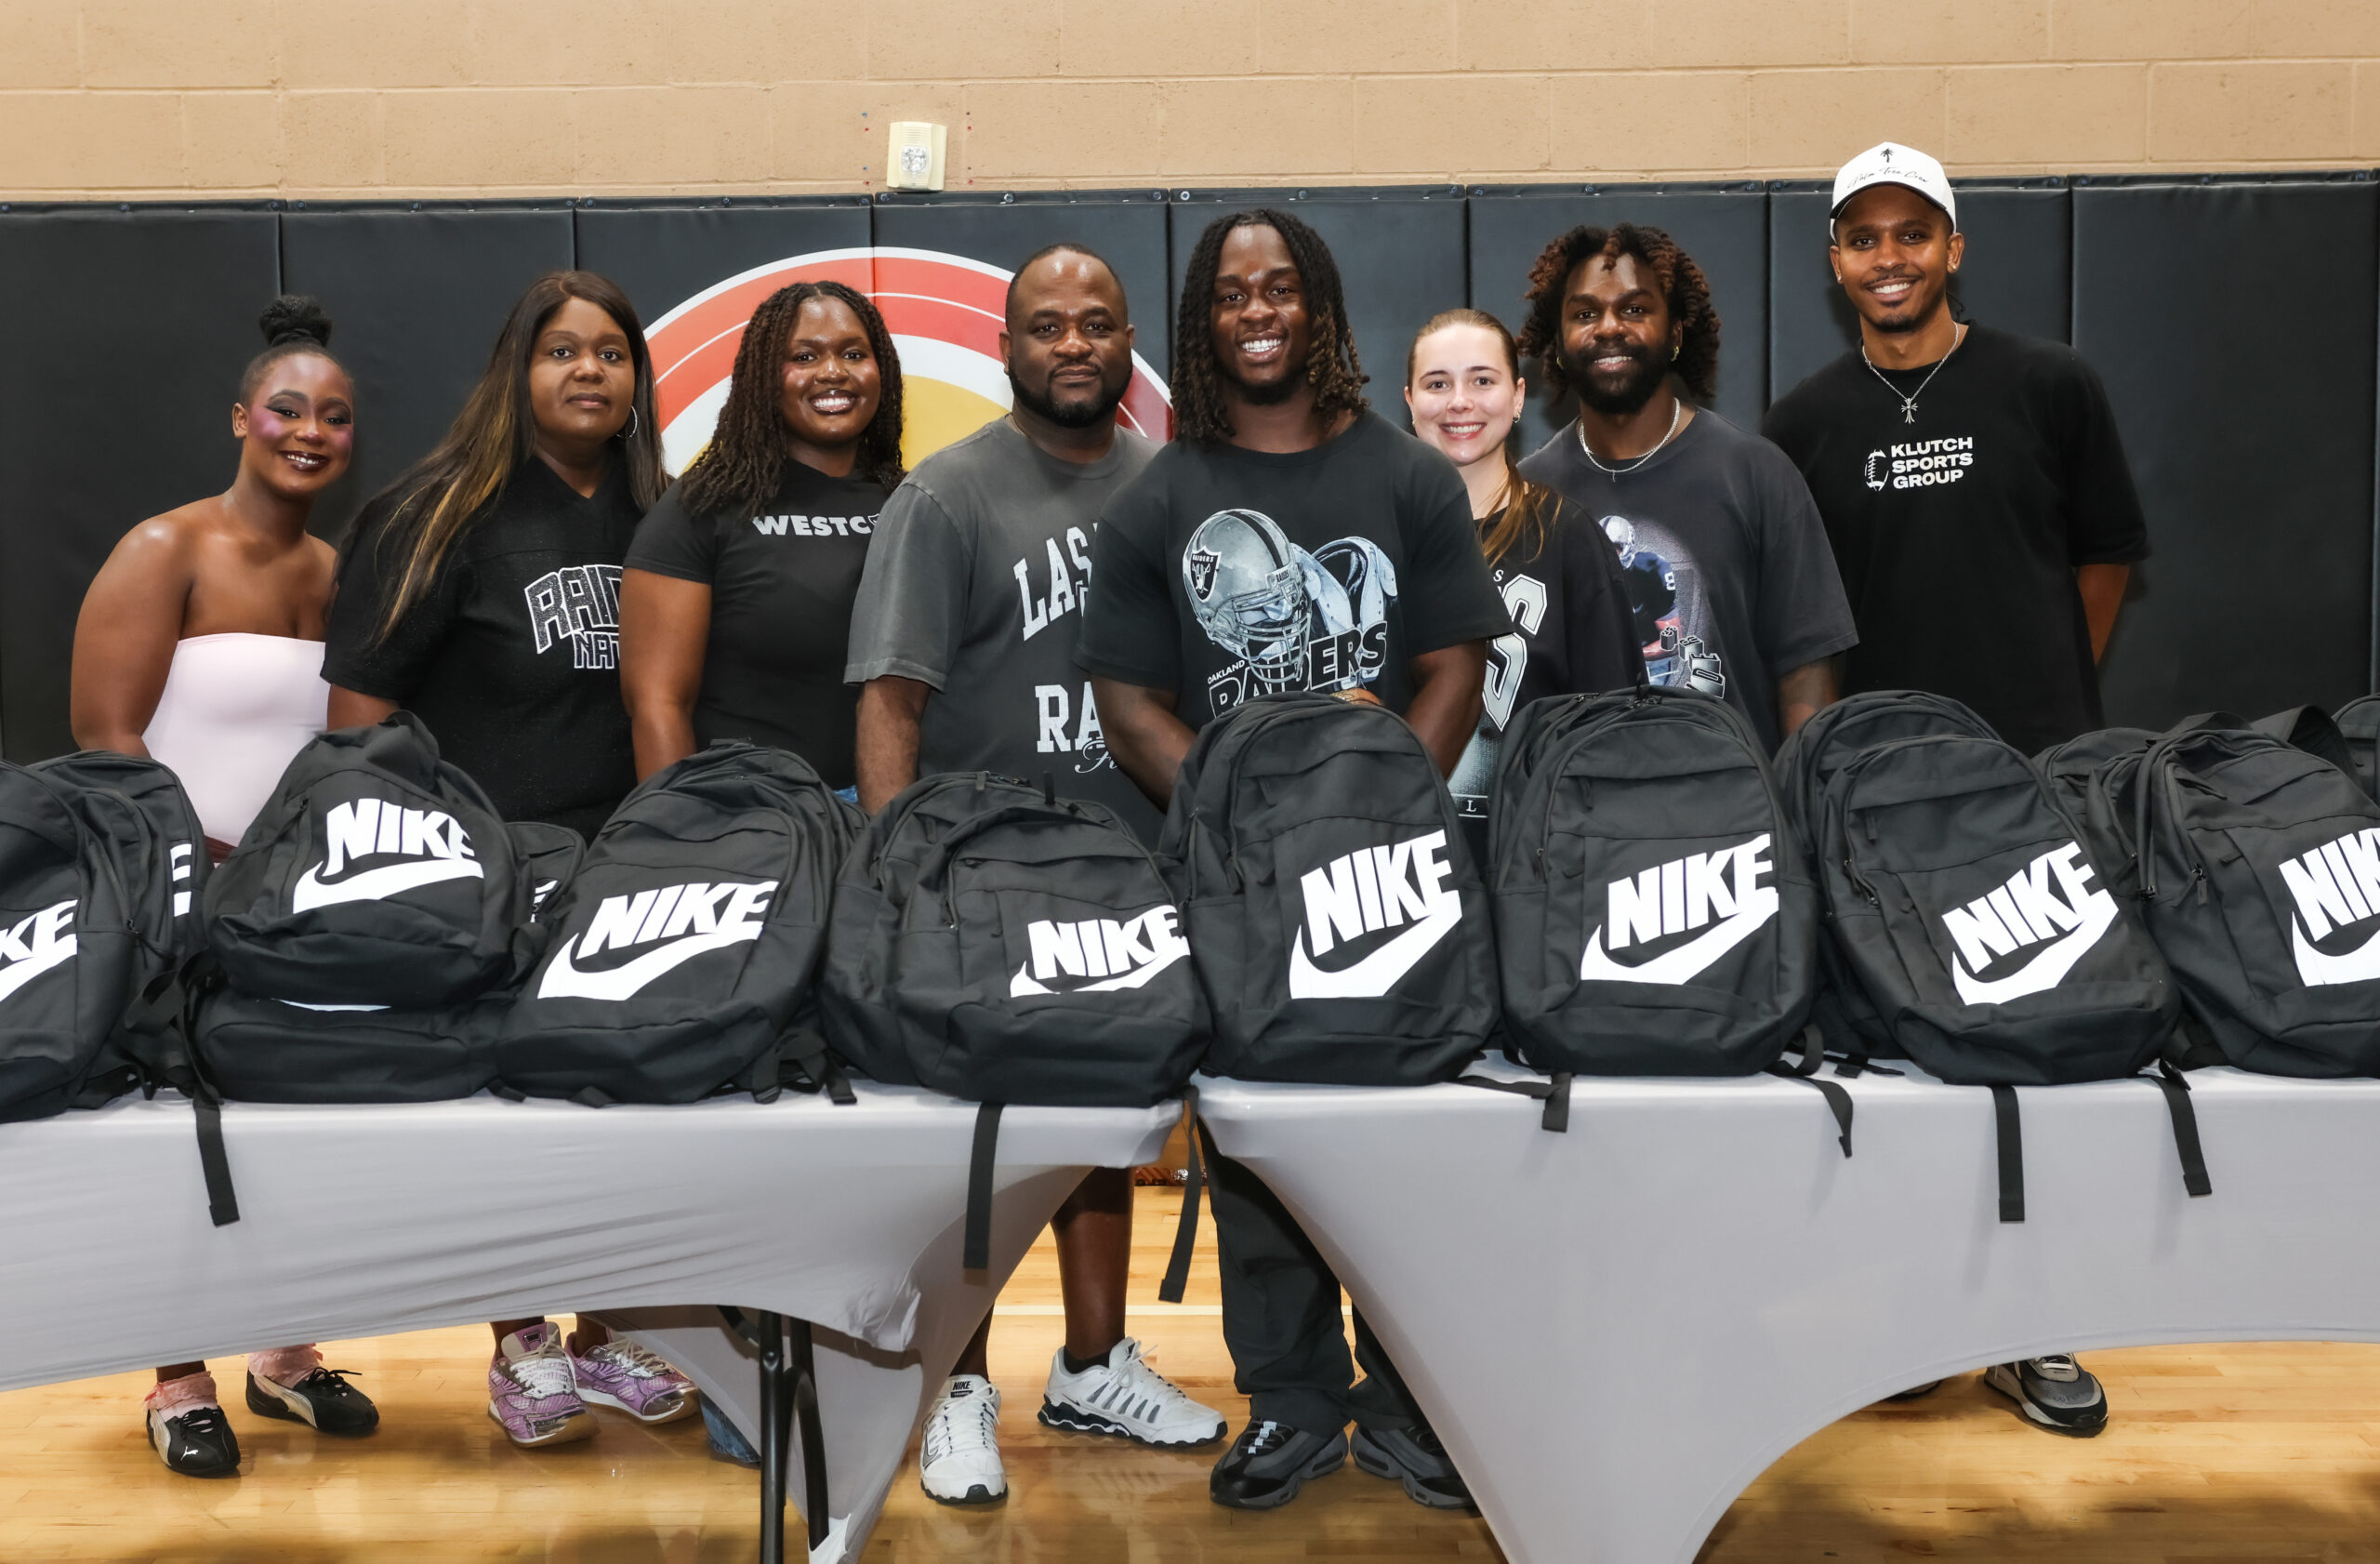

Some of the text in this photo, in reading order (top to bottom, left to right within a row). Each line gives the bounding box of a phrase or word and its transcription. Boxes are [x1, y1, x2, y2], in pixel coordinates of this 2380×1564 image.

[1891, 436, 1973, 457] KLUTCH
[1892, 452, 1974, 473] SPORTS
[1893, 469, 1964, 489] GROUP
[1207, 659, 1246, 684] OAKLAND
[321, 797, 476, 877] NIKE
[576, 881, 779, 959] NIKE
[1301, 828, 1460, 957] NIKE
[1607, 833, 1778, 950] NIKE
[1941, 841, 2110, 974] NIKE
[2278, 827, 2380, 943] NIK
[0, 899, 78, 961] KE
[1027, 904, 1190, 980] NIKE
[953, 1381, 972, 1391] NIKE
